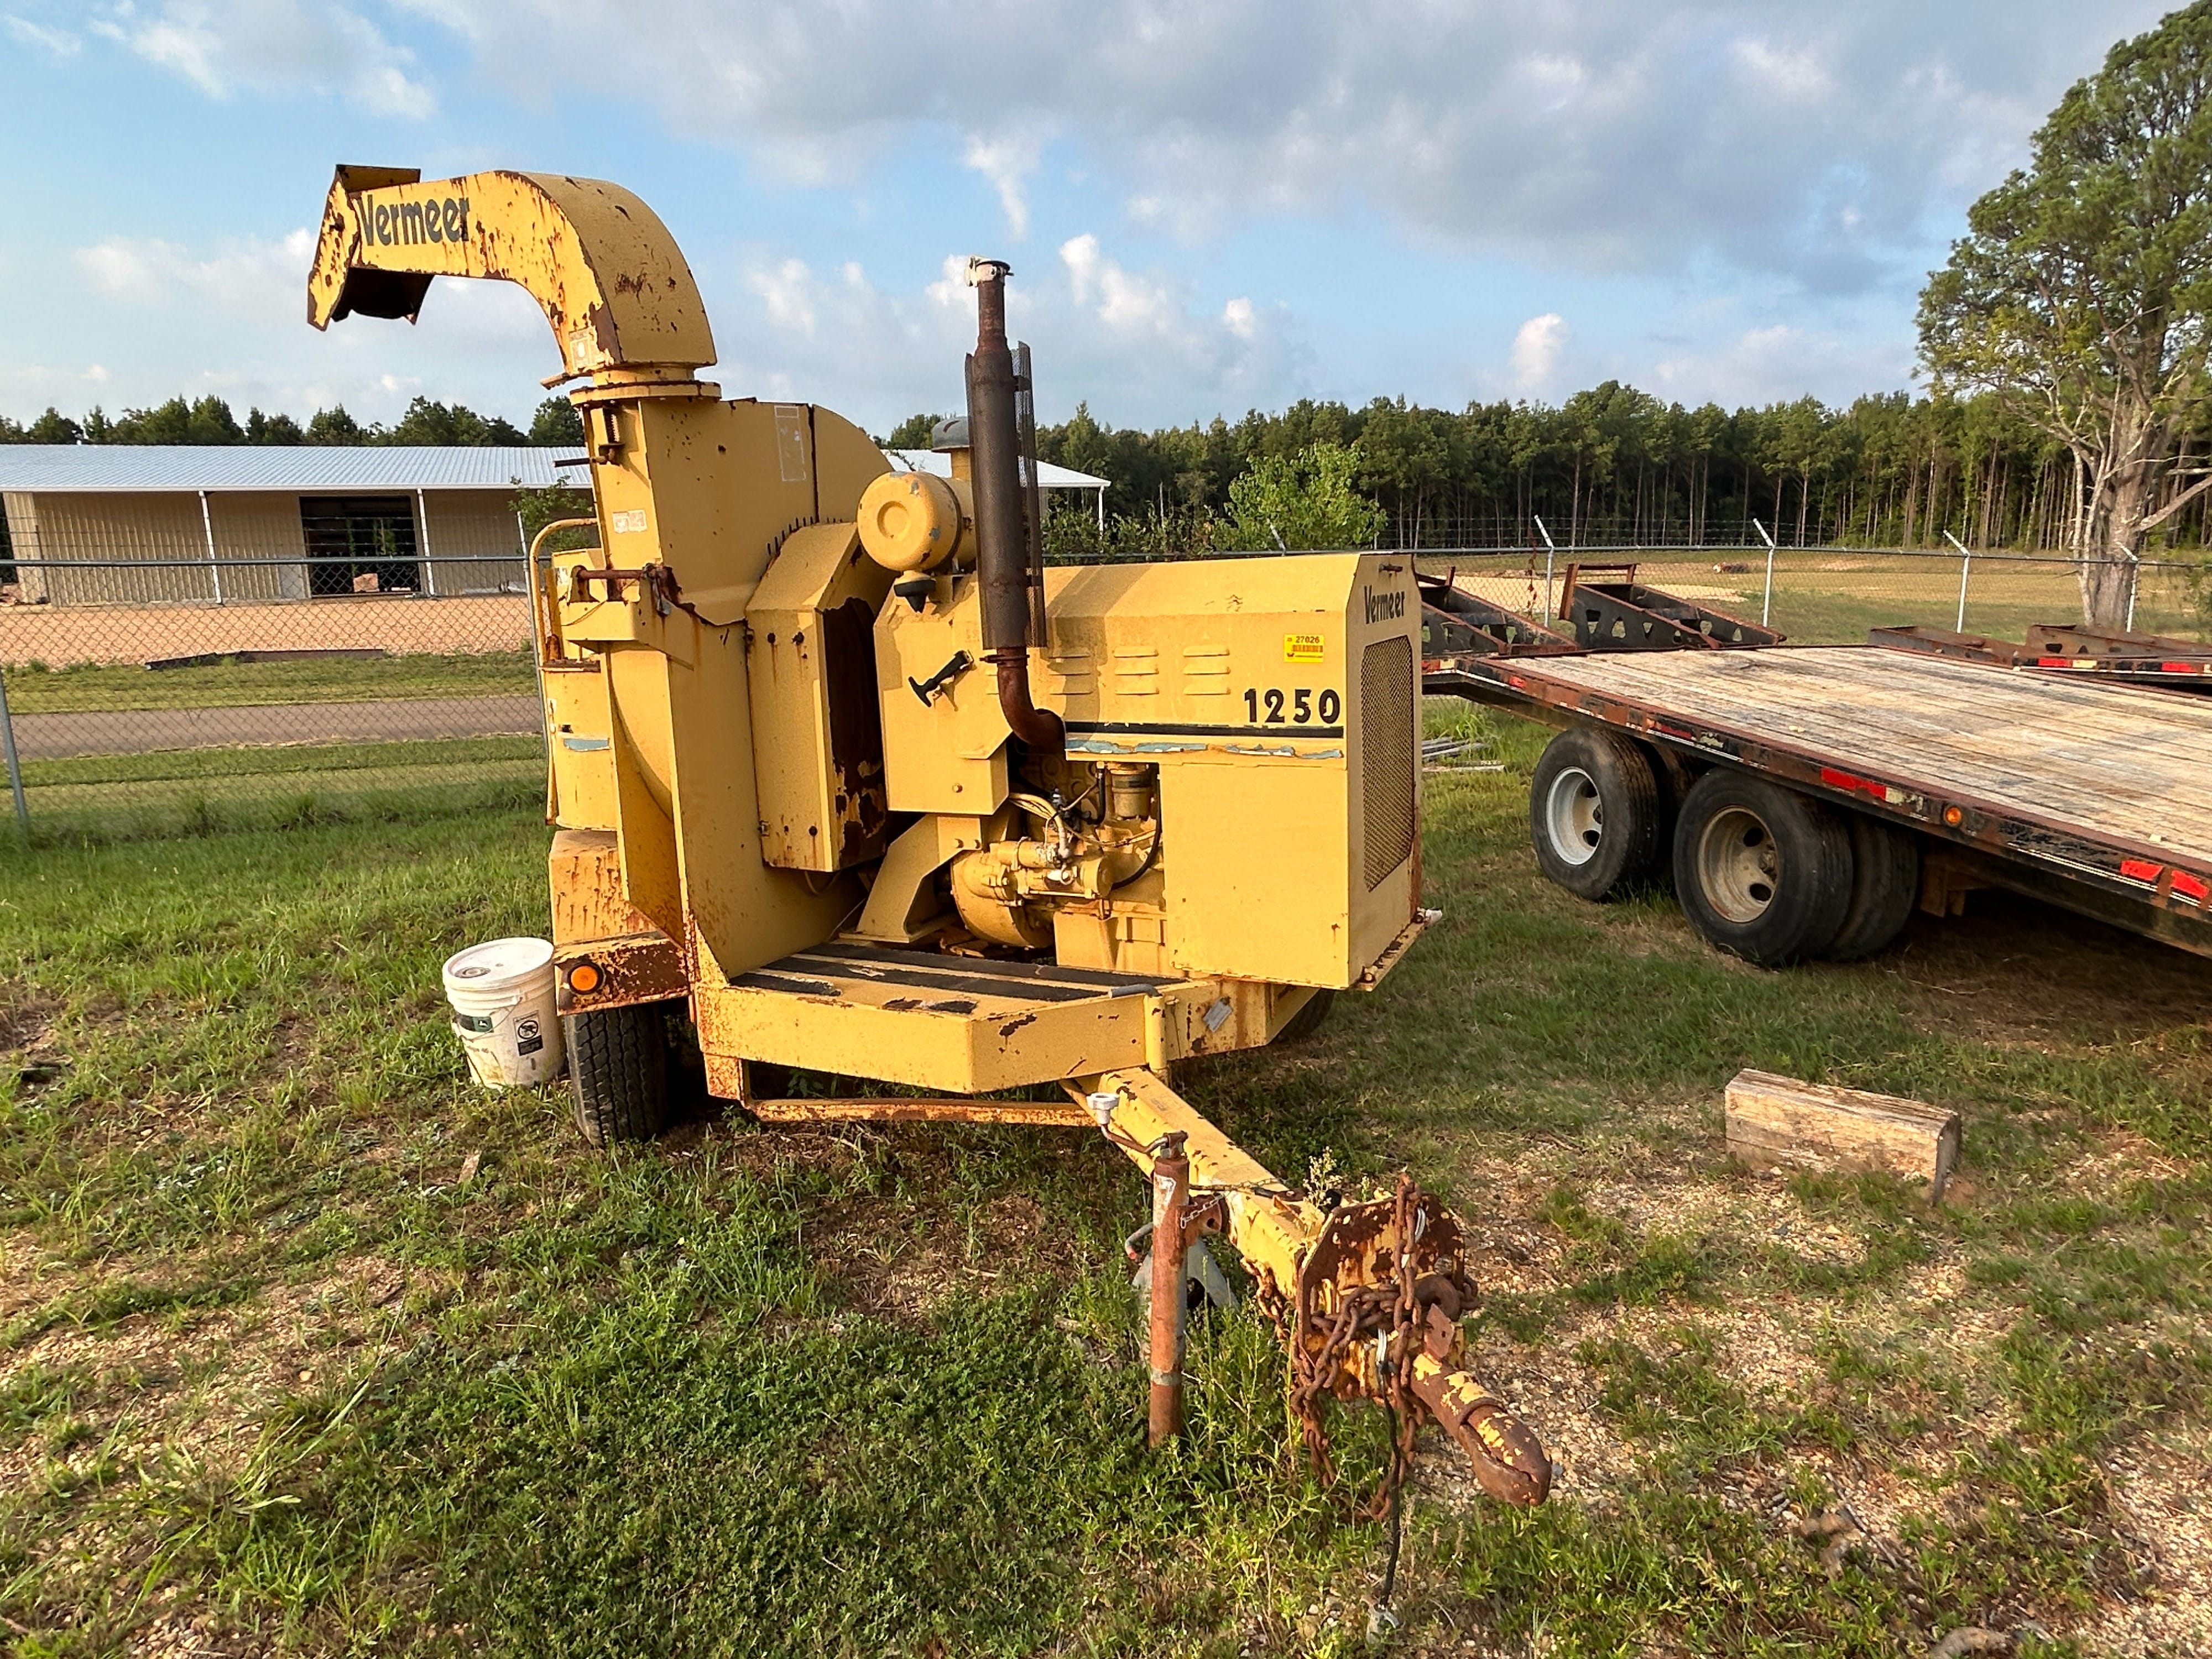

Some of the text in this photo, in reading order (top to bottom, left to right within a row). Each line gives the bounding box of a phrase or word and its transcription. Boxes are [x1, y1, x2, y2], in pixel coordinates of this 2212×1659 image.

[357, 195, 469, 246] Vermeer
[1364, 585, 1405, 624] Vermeer
[1244, 688, 1340, 724] 1250
